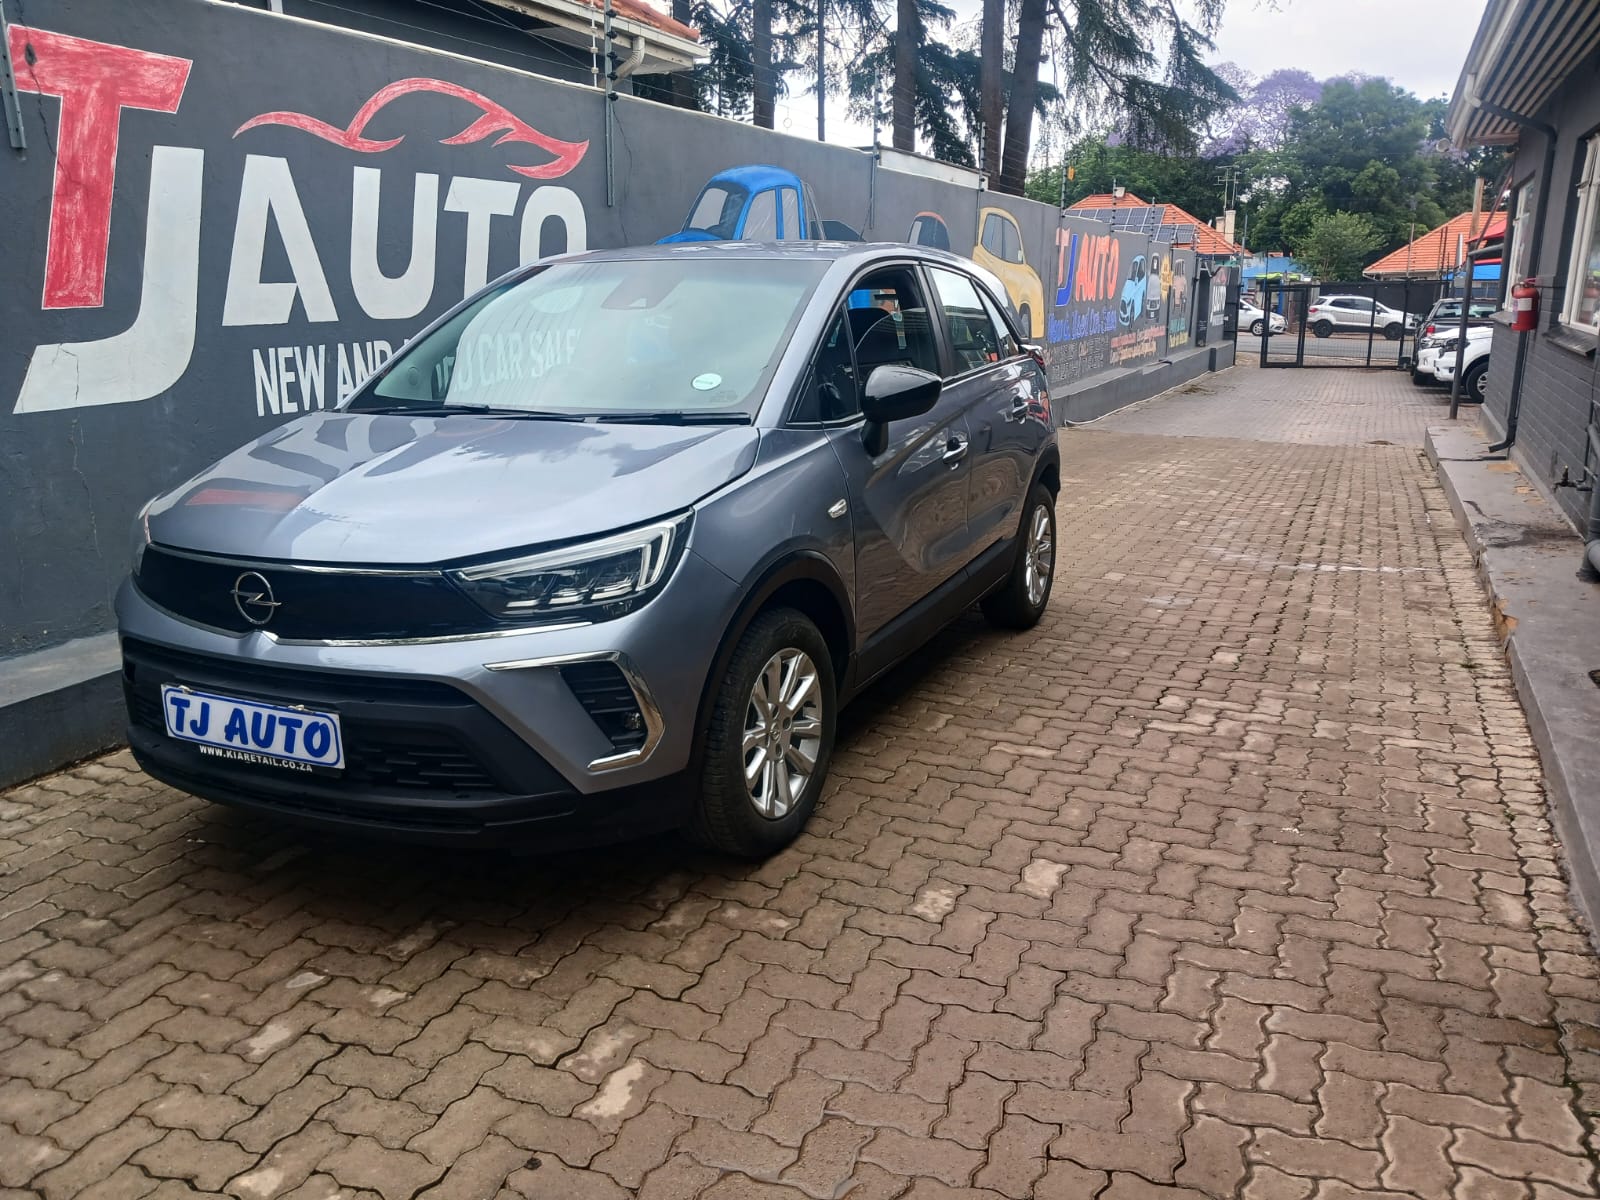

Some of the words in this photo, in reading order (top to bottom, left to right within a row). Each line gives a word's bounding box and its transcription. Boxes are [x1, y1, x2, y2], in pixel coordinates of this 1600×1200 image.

[8, 23, 205, 414] TJ
[1075, 231, 1119, 302] AUTO
[252, 344, 326, 417] NEW
[170, 697, 210, 737] TJ
[224, 707, 331, 759] AUTO
[199, 745, 313, 773] WWW.KIARETAIL.CO.ZA
